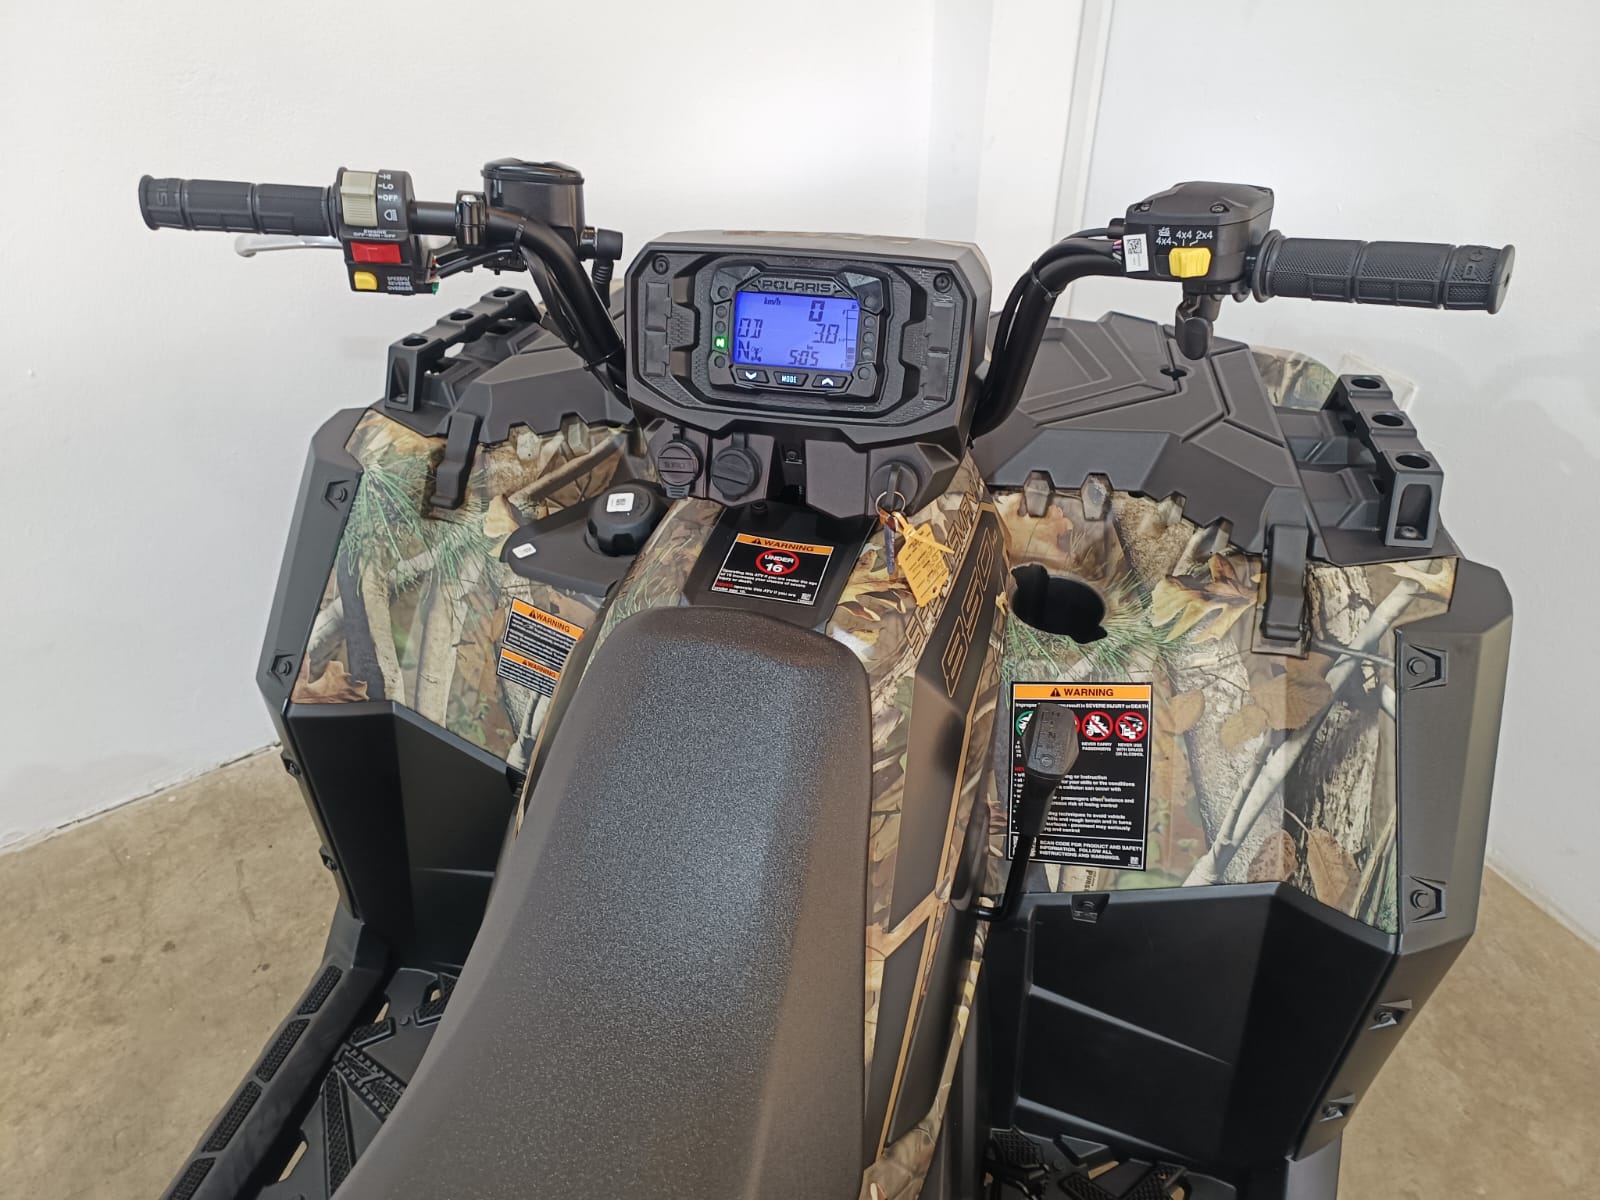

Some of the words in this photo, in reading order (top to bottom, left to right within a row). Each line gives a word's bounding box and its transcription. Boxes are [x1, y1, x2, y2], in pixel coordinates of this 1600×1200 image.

[1176, 230, 1192, 239] 4x4
[1196, 230, 1213, 239] 2x4
[1156, 237, 1172, 245] 4x4
[762, 280, 831, 292] POLARIS
[764, 297, 782, 306] km/h
[808, 300, 825, 322] 0
[738, 340, 750, 360] N
[782, 375, 797, 384] MODE
[764, 540, 814, 552] WARNING
[764, 554, 794, 563] UNDER
[766, 563, 783, 573] 16
[942, 526, 994, 698] 850
[536, 612, 570, 633] WARNING
[527, 662, 556, 678] WARNING
[1064, 688, 1114, 697] WARNING
